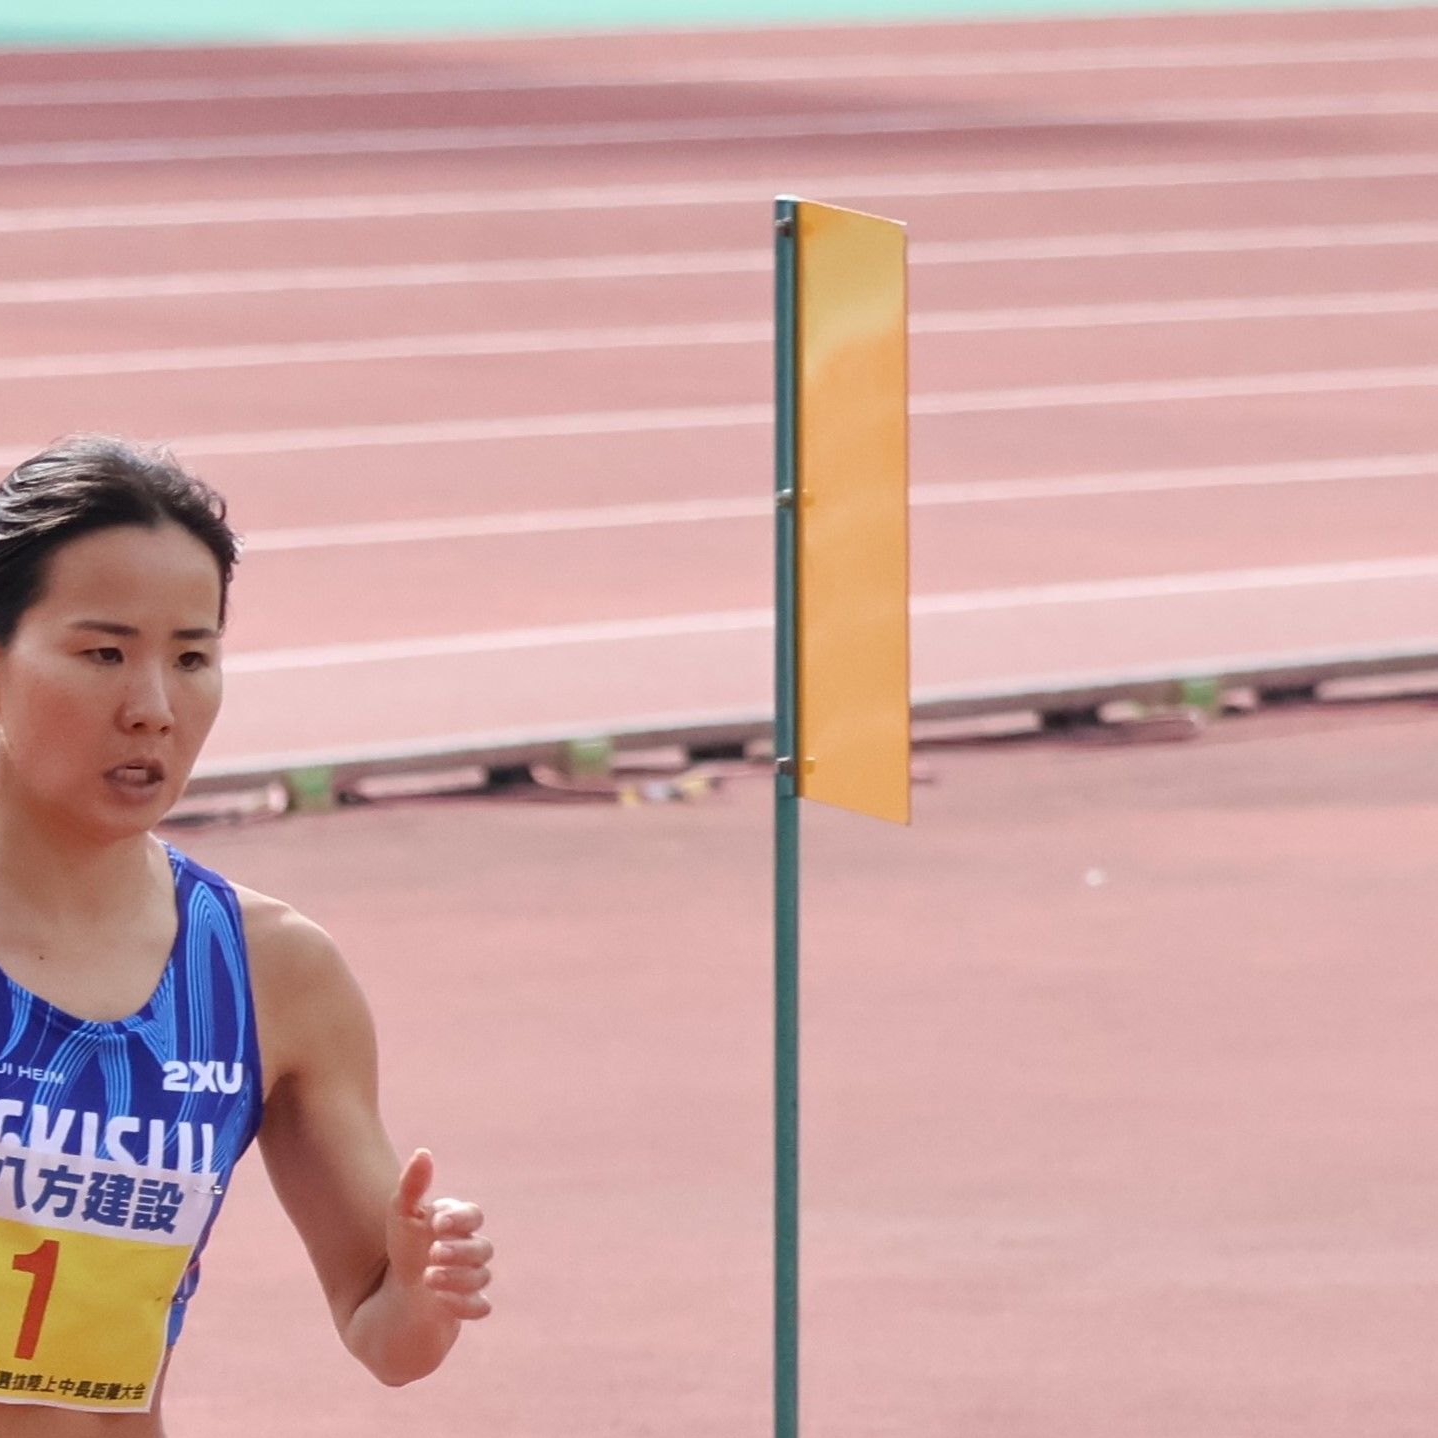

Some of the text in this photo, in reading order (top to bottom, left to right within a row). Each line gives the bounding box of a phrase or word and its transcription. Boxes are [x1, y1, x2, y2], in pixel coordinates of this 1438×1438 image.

[18, 1065, 65, 1086] HEIM
[162, 1060, 244, 1095] 2XU
[11, 1239, 60, 1361] 1
